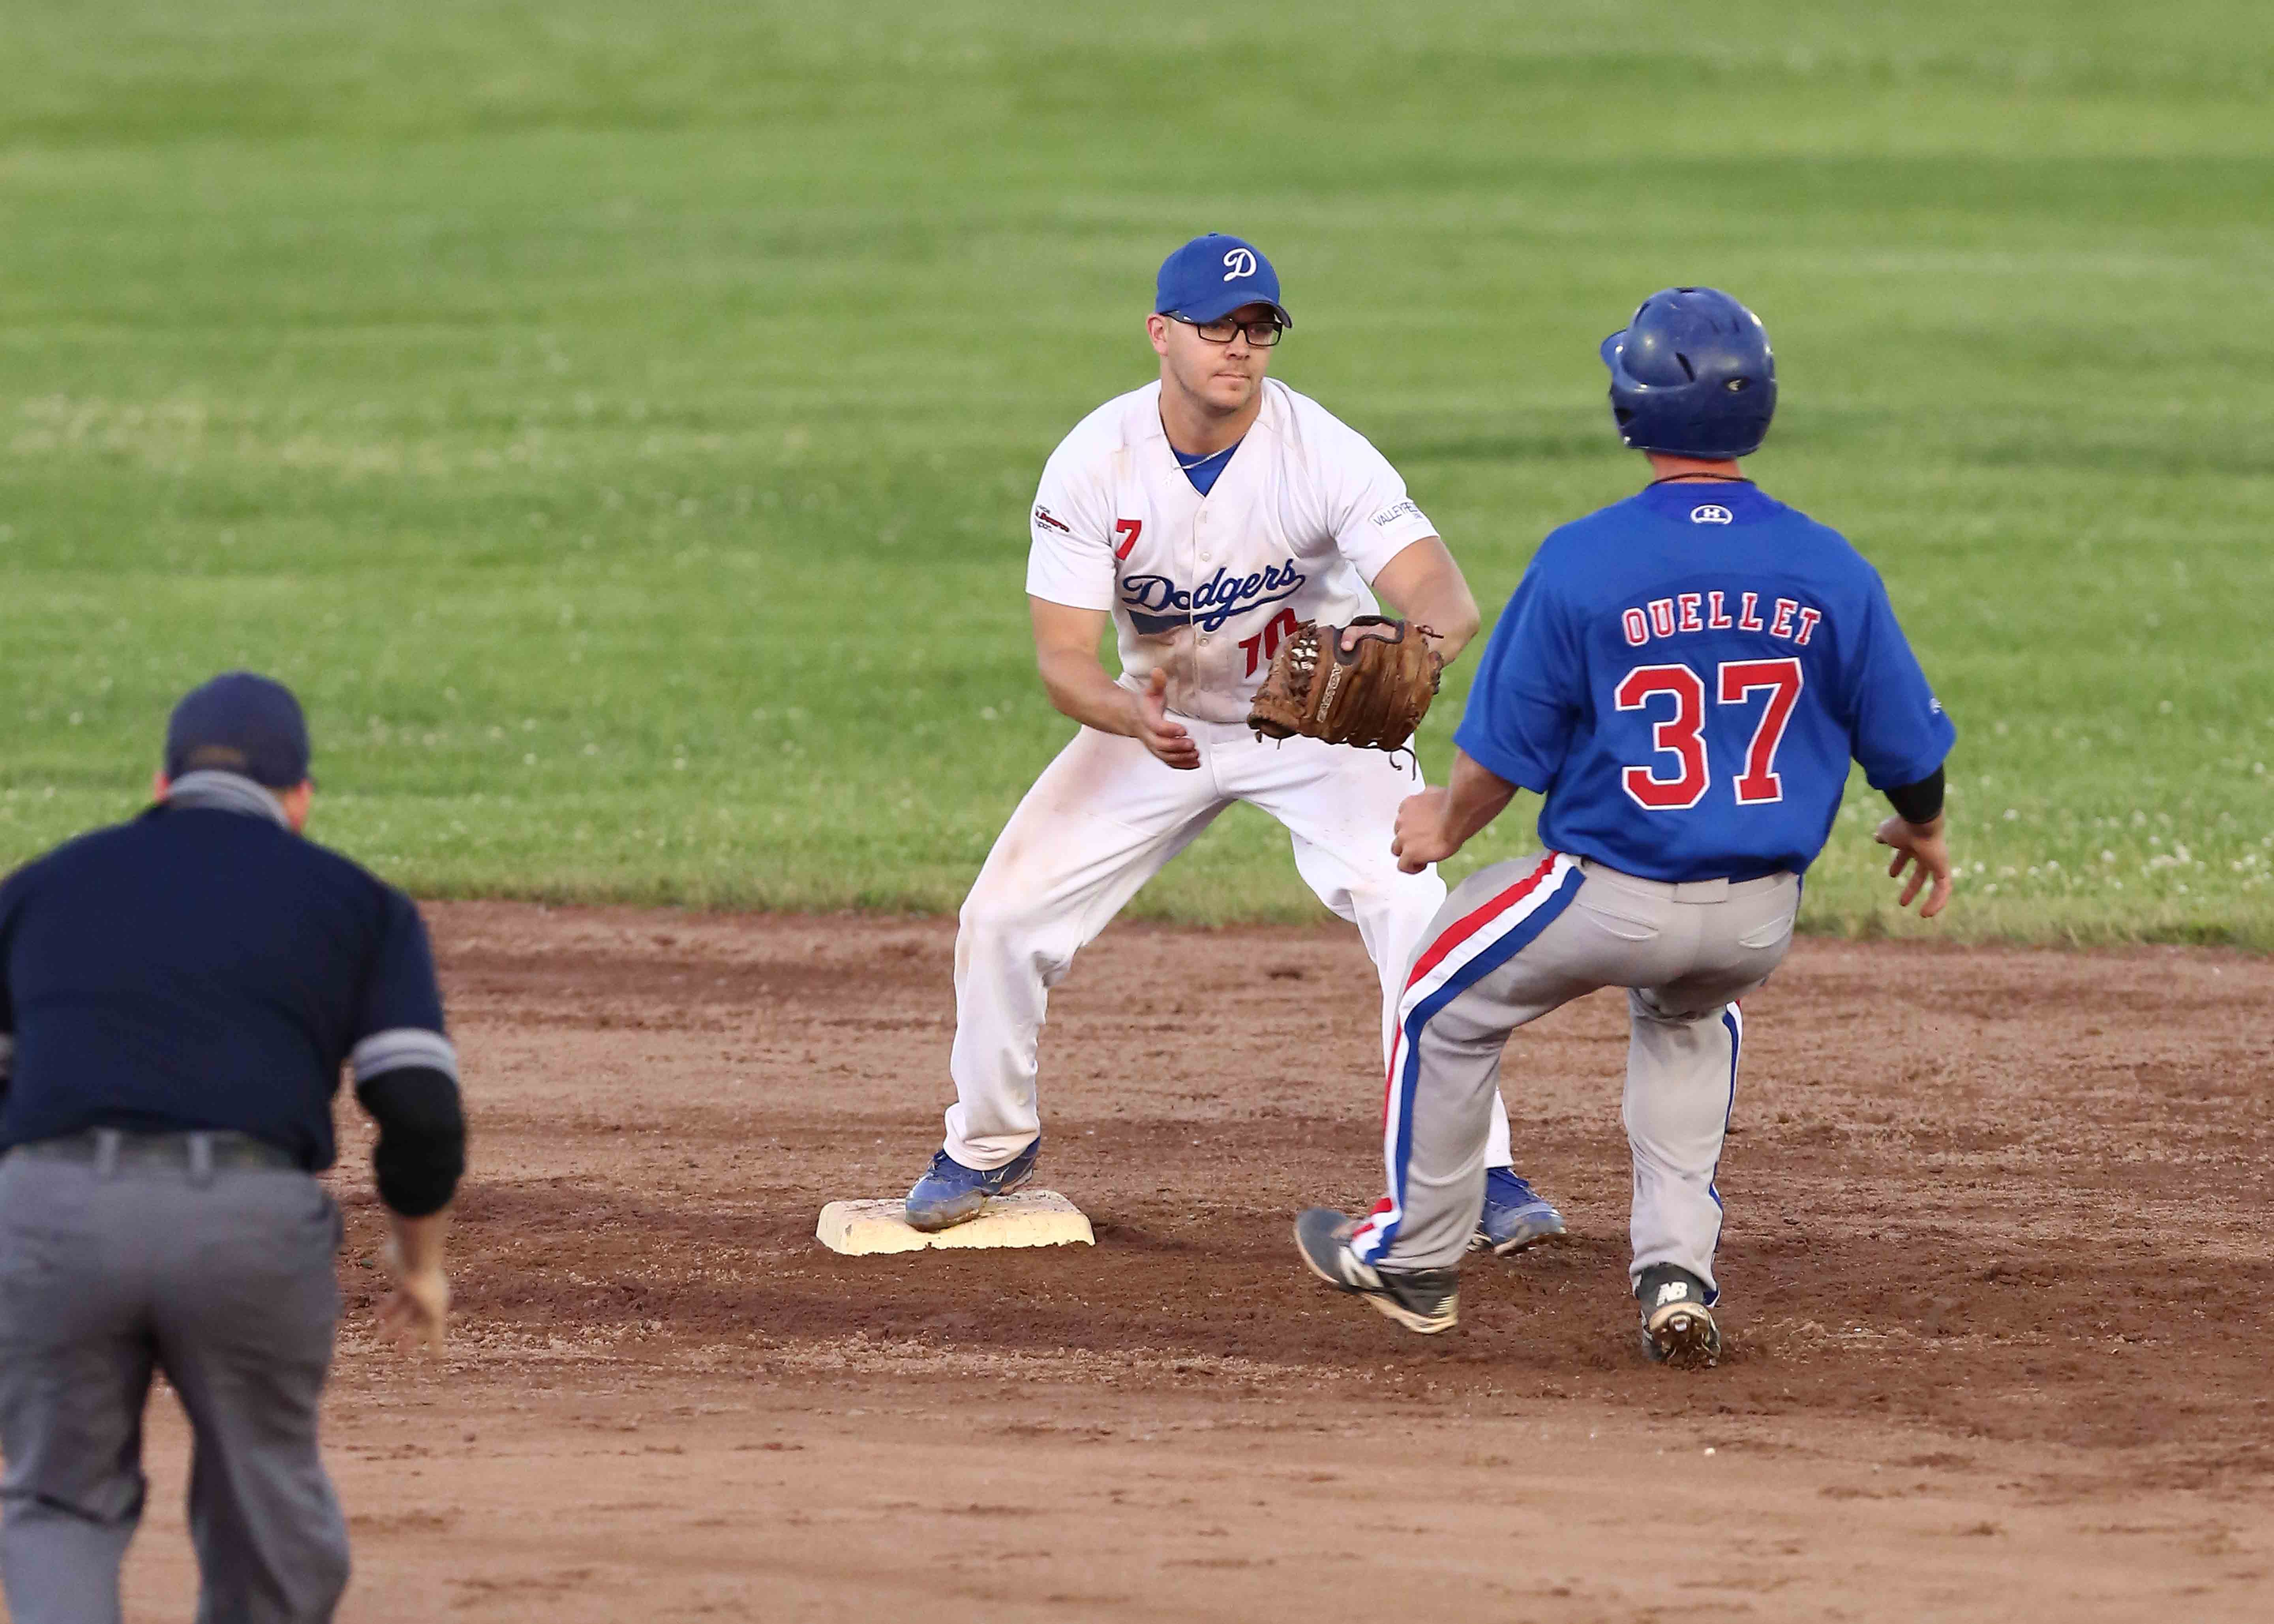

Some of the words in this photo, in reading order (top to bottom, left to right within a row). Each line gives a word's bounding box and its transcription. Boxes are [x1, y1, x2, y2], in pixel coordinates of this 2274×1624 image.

[1223, 247, 1257, 281] D
[1115, 518, 1142, 561] 7
[1122, 558, 1306, 634] Dodgers
[1622, 591, 1821, 647] OUELLET
[1614, 657, 1804, 810] 37
[1656, 1281, 1688, 1307] NB
